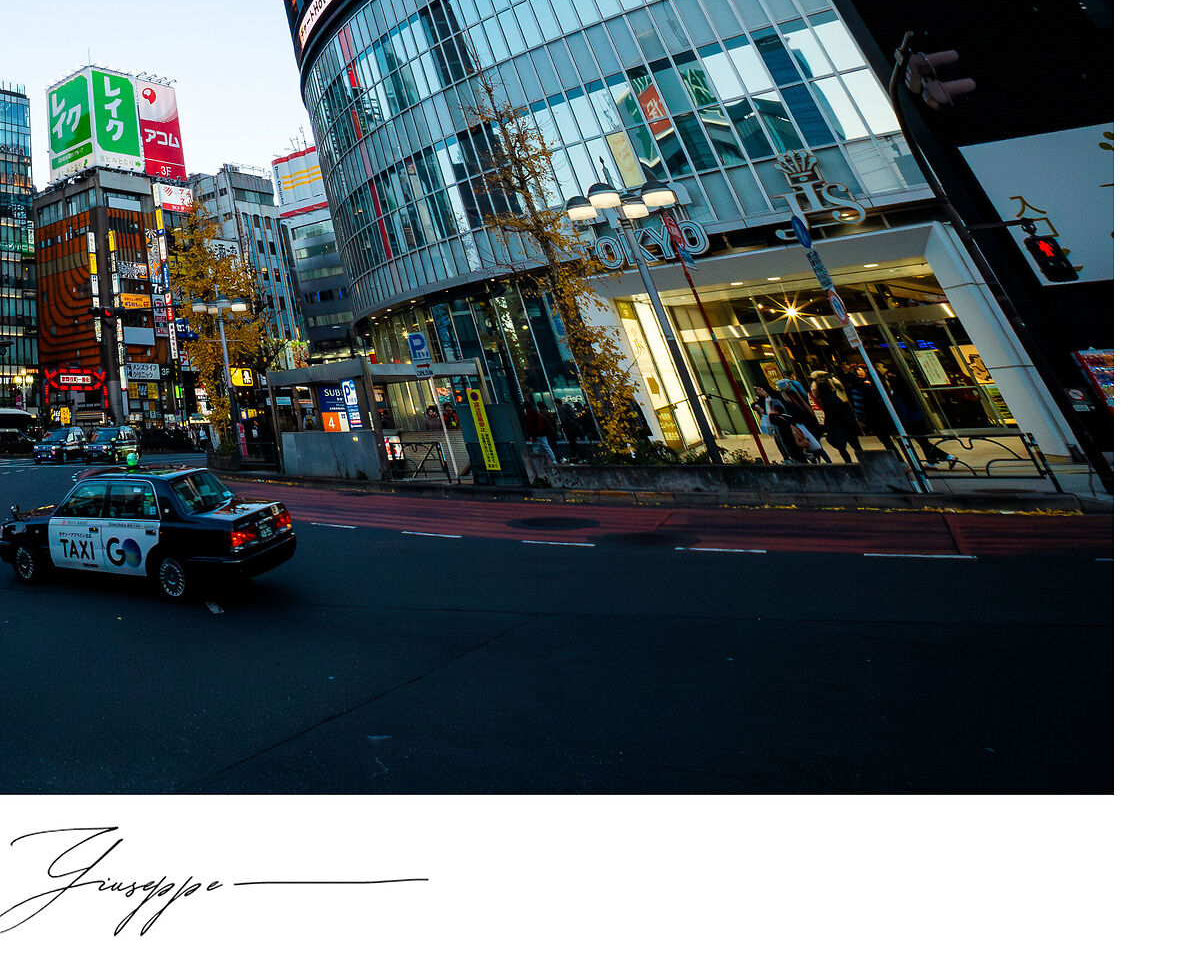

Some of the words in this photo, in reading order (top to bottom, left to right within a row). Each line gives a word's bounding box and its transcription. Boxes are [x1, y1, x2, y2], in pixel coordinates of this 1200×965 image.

[51, 92, 82, 139] レイク
[103, 75, 125, 142] レイク
[144, 128, 181, 148] アコム
[582, 219, 710, 270] OKYO
[409, 333, 425, 358] P
[328, 417, 336, 429] 4
[59, 538, 95, 561] TAXI
[106, 536, 142, 568] GO
